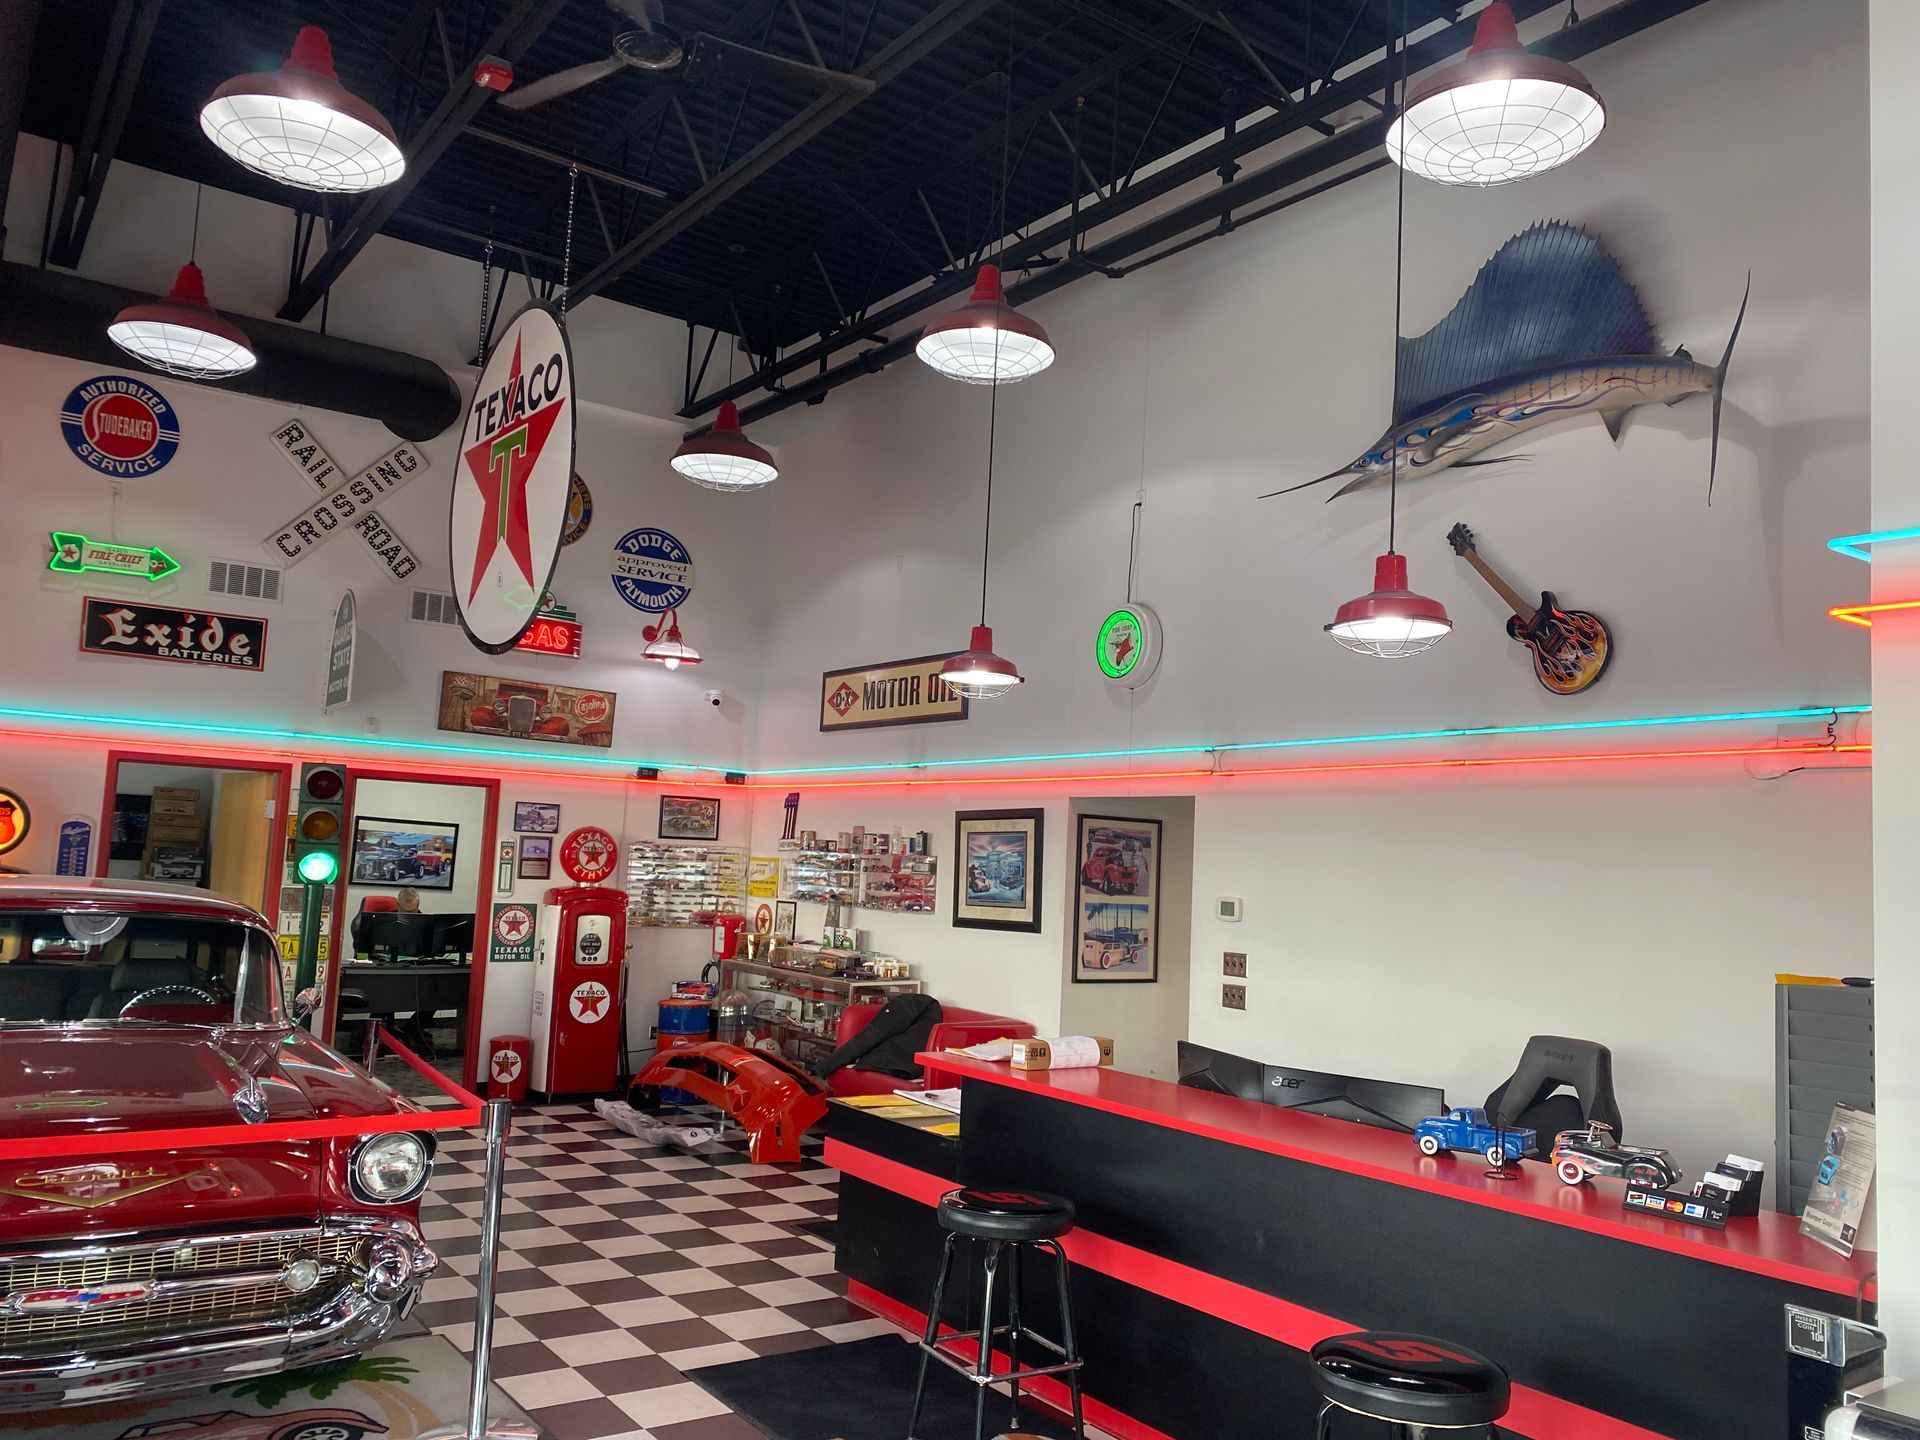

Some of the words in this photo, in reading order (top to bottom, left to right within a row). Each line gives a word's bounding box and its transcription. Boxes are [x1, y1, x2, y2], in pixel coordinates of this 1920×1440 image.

[80, 381, 166, 414] AUTHORIZED
[475, 353, 563, 442] TEXACO
[92, 394, 153, 443] STUDEBAKER
[77, 443, 161, 474] SERVICE
[277, 423, 334, 489] RAIL
[276, 449, 417, 557] CROSSING
[88, 550, 144, 564] FIRE-CHIEF
[354, 513, 416, 578] ROAD
[625, 534, 682, 560] DODGE
[617, 556, 687, 572] approved
[617, 564, 688, 583] SERVICE
[620, 579, 683, 607] PLYMOUTH
[100, 608, 250, 656] Exide
[158, 646, 253, 666] BATTERIES
[862, 675, 921, 711] MOTOR
[571, 833, 613, 851] TEXACO
[572, 864, 610, 880] ETHYL
[1271, 1075, 1306, 1090] acer
[15, 1166, 168, 1187] Chevrolet
[1805, 1210, 1823, 1225] Bumper
[1822, 1217, 1834, 1229] Color
[1794, 1314, 1817, 1324] INSERT
[1797, 1322, 1815, 1332] COIN
